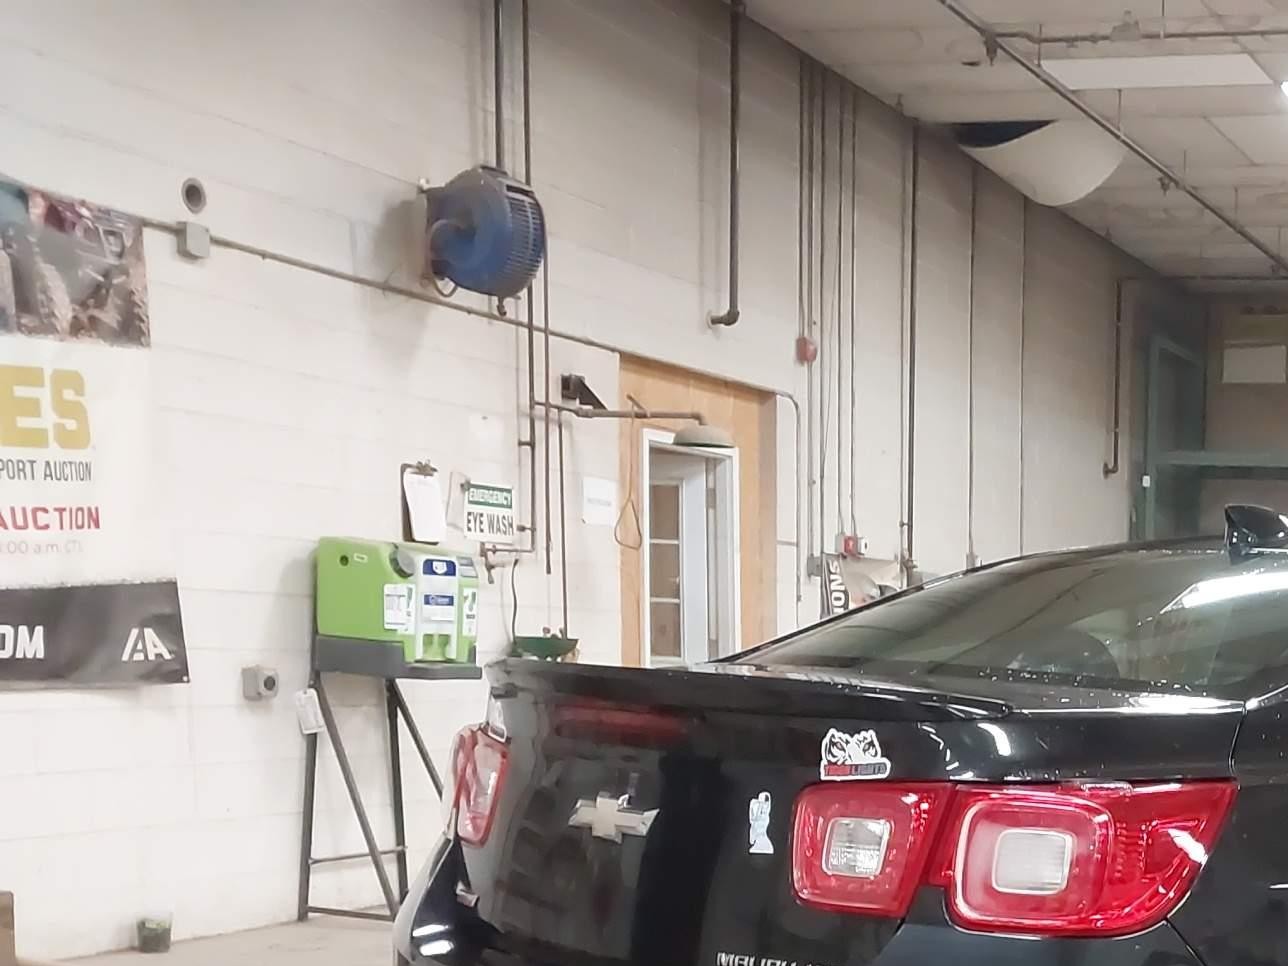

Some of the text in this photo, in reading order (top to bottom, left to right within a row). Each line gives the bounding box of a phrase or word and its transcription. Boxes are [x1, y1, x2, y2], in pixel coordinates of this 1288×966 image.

[43, 459, 92, 482] AUCTION
[469, 487, 512, 506] EMERGENCY
[467, 511, 514, 537] EYE WASH
